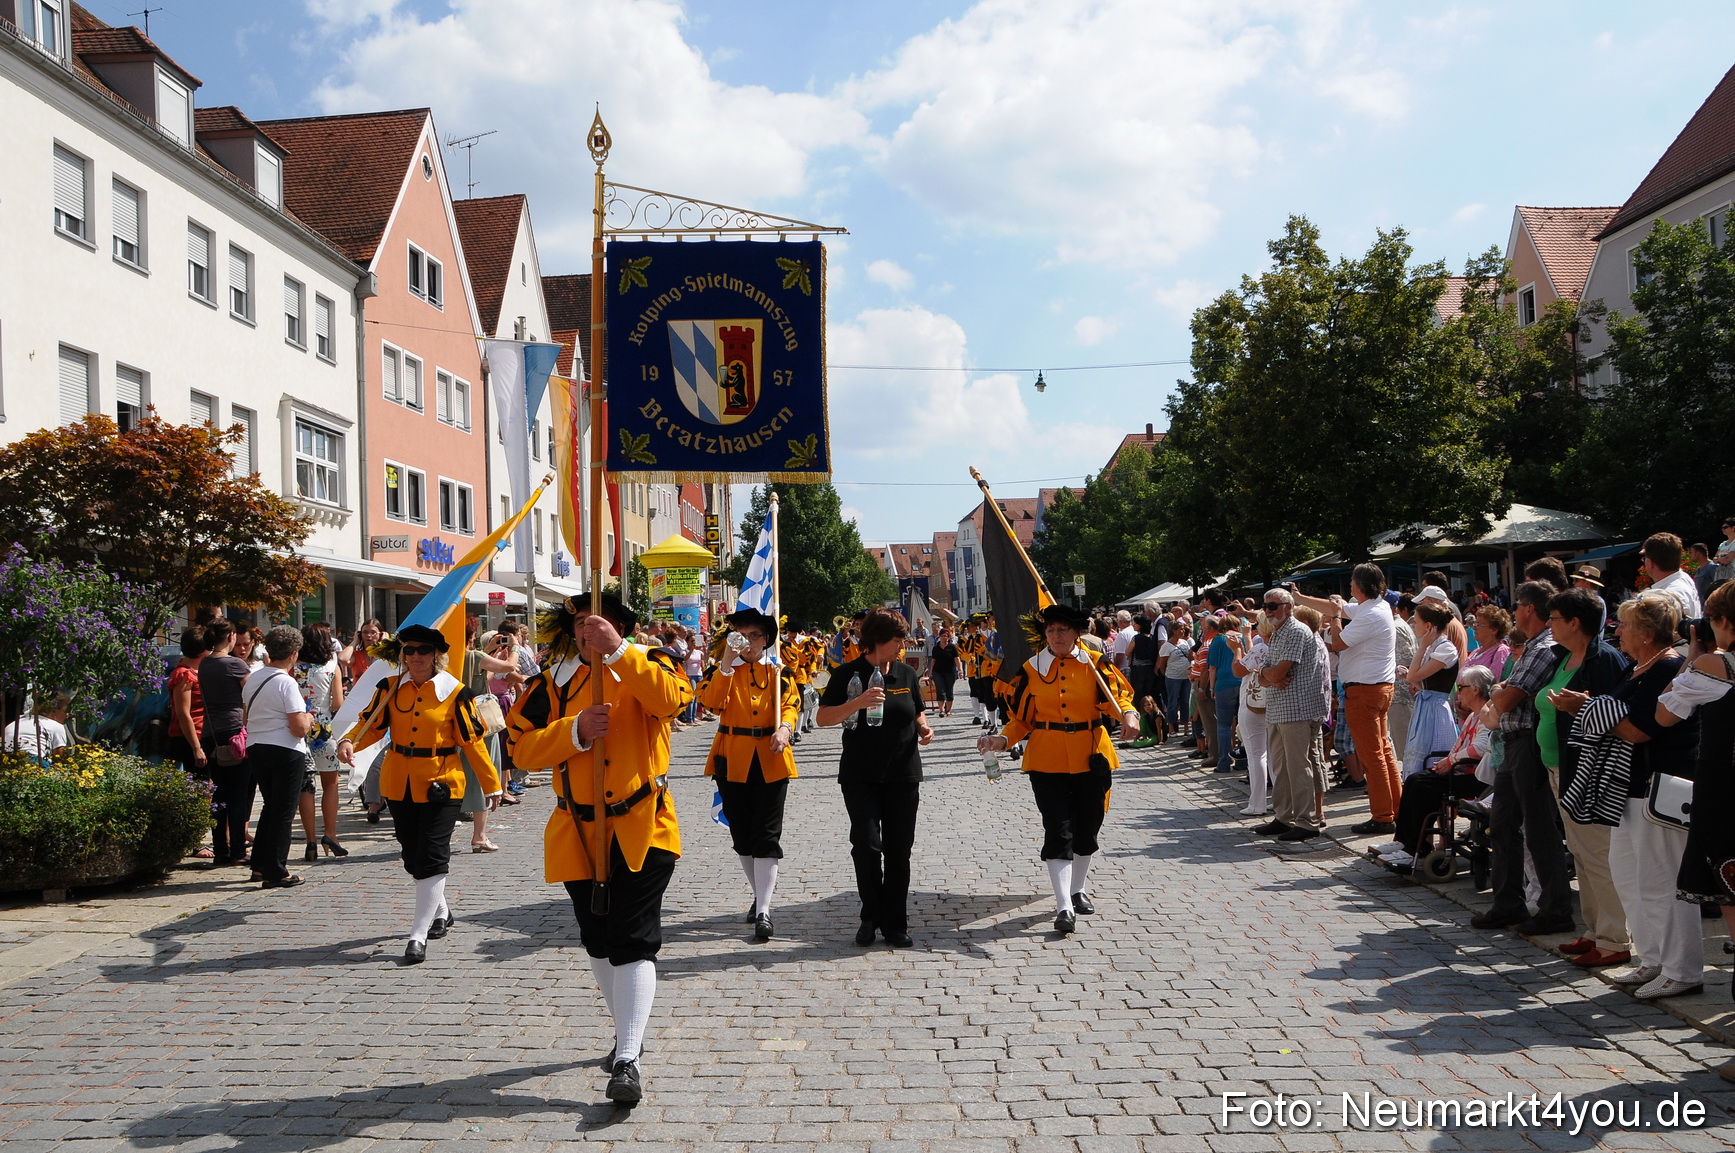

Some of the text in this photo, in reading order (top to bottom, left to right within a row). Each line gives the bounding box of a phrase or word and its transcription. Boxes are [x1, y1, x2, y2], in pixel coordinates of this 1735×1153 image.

[628, 272, 799, 352] Kolping-Spielmannszug
[640, 364, 794, 387] 19 57
[637, 397, 794, 454] Beratzhausen
[706, 515, 720, 584] HOTEL
